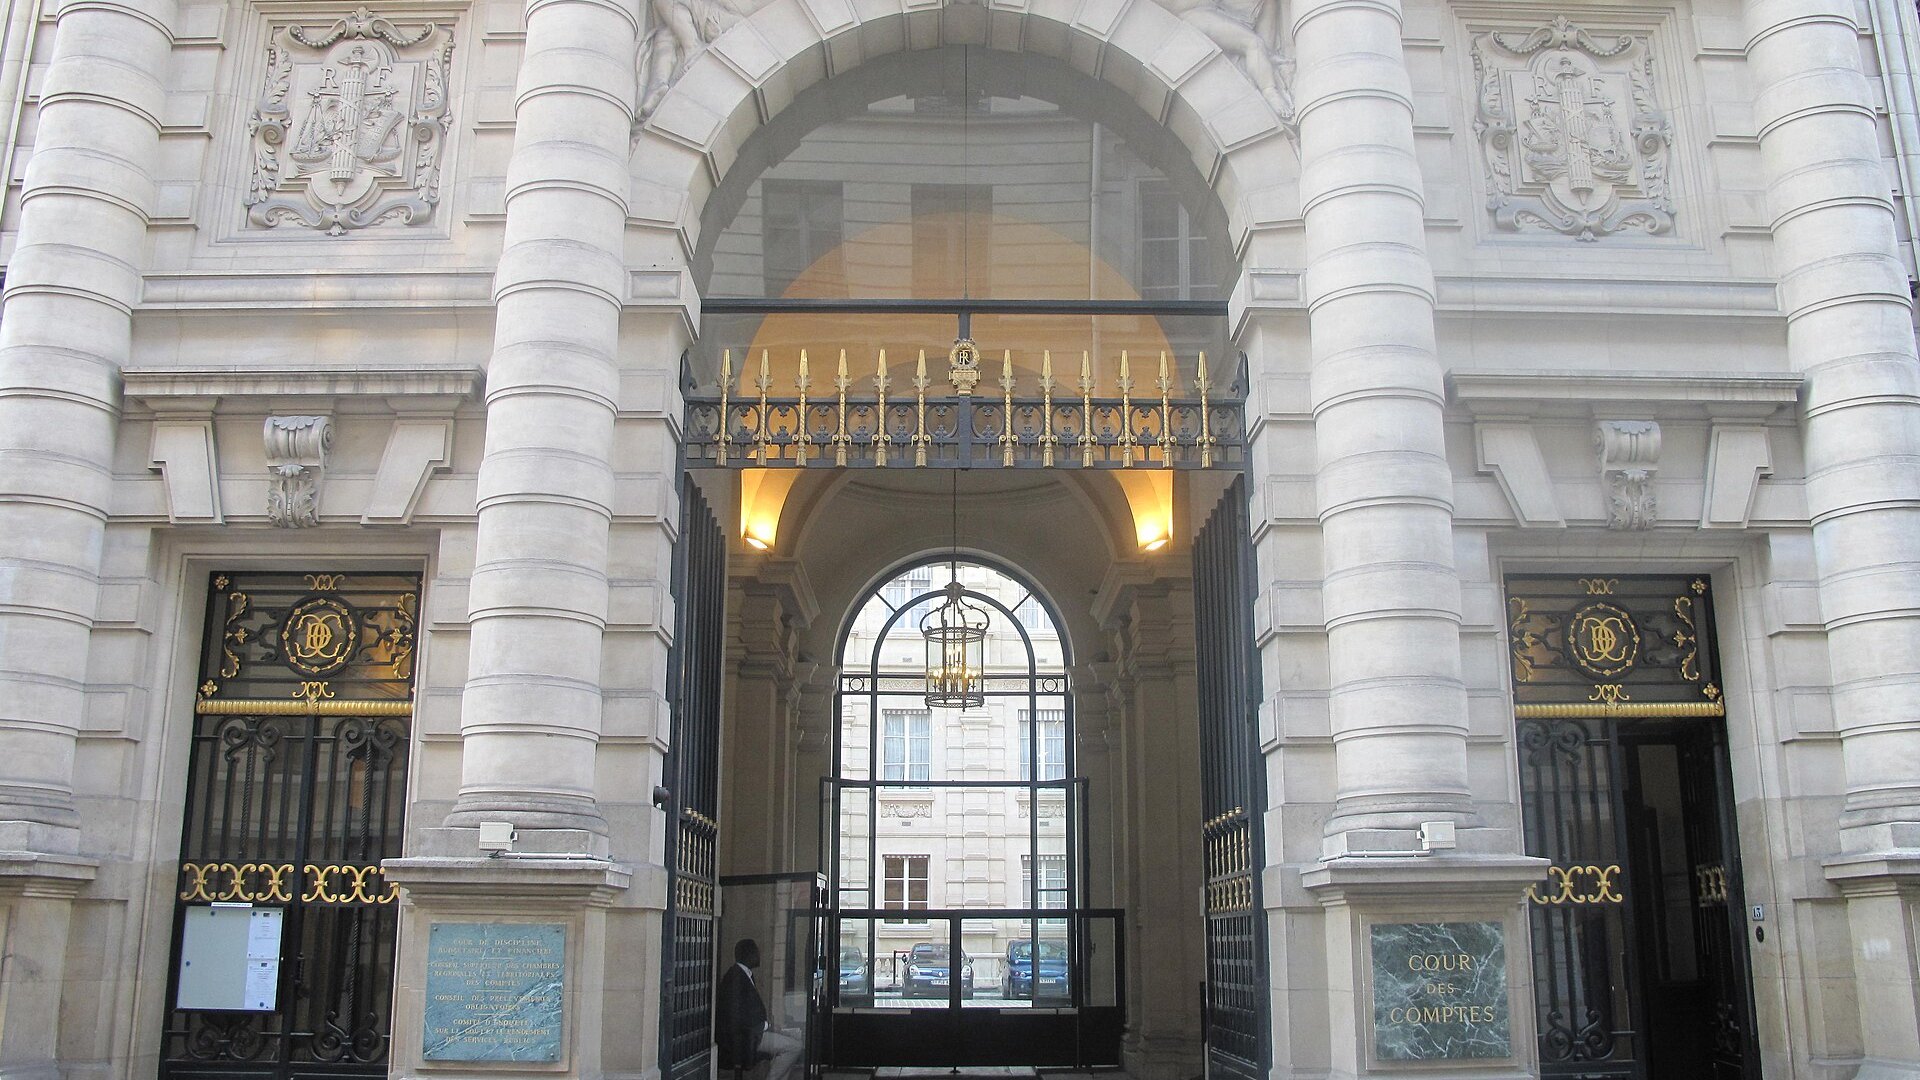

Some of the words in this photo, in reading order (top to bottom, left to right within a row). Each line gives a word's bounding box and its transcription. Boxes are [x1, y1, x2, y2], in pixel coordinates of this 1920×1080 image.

[1408, 954, 1472, 971] COUR
[1426, 983, 1455, 994] DES
[1390, 1006, 1495, 1024] COMPTES
